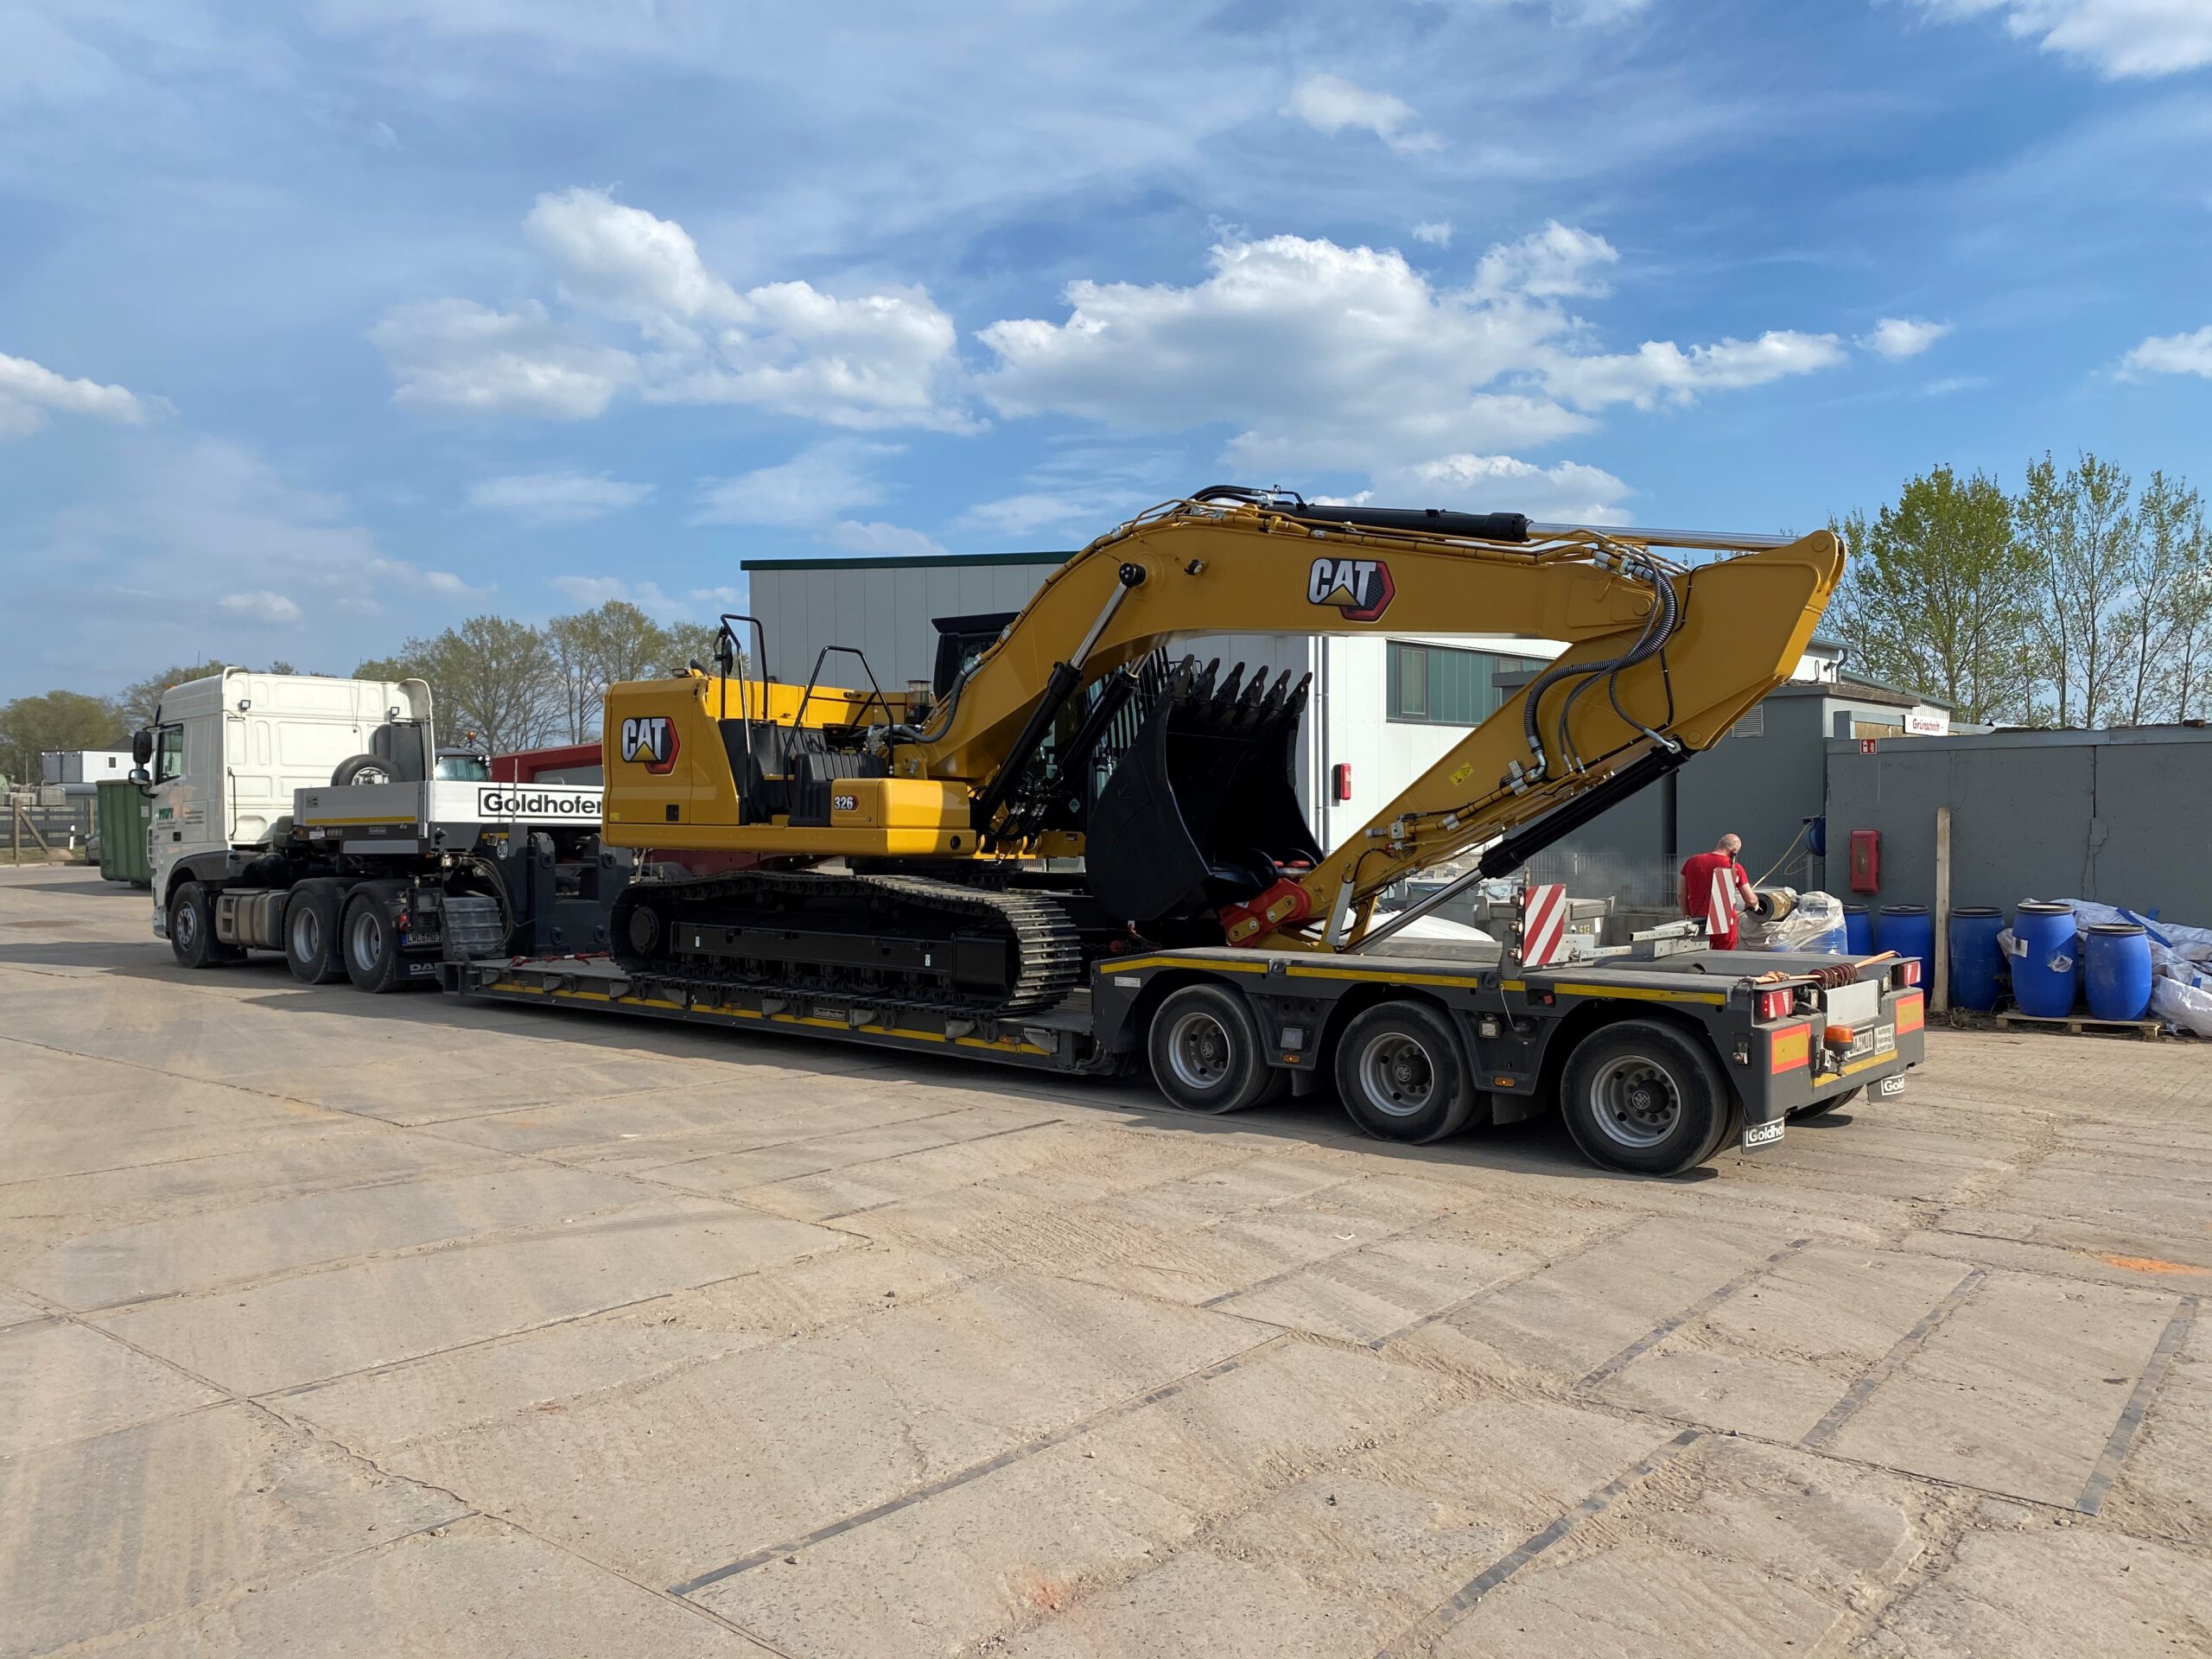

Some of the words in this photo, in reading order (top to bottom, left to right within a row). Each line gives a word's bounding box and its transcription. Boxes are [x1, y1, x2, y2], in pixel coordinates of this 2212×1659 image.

[1308, 558, 1377, 607] CAT
[622, 718, 666, 761] CAT
[834, 796, 854, 810] 326
[815, 1008, 844, 1020] Goldhofer
[1885, 1077, 1904, 1090] Gold
